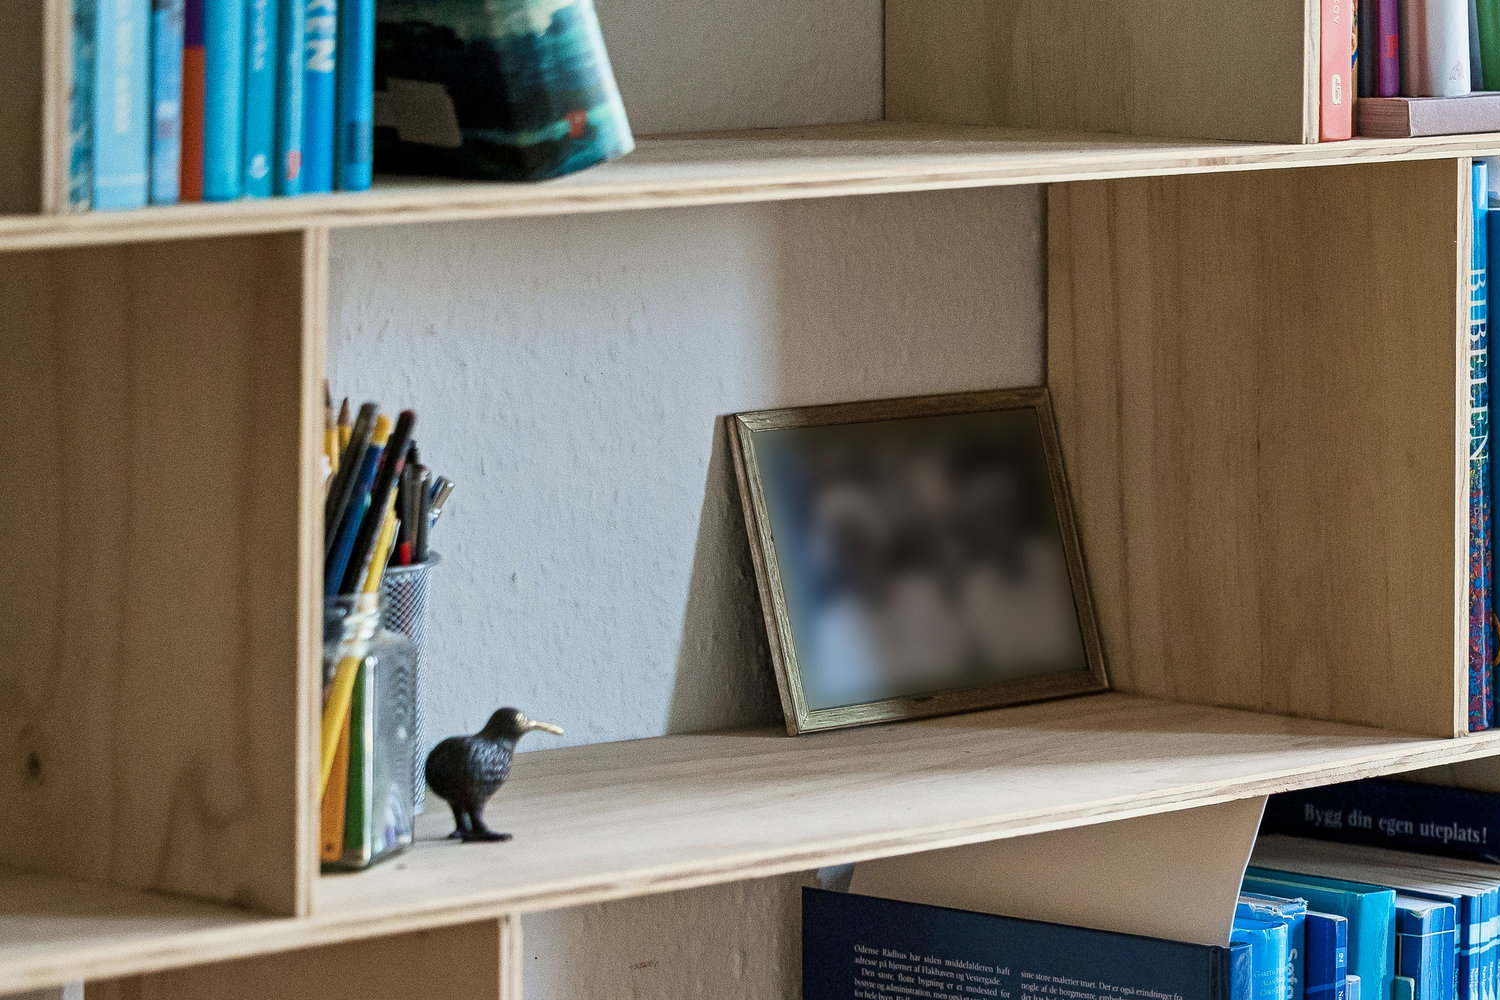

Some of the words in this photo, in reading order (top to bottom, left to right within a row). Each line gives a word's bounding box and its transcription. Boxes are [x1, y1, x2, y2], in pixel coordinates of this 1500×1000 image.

[1470, 268, 1489, 461] BIBELEN
[1305, 803, 1343, 829] Bygg
[1348, 810, 1371, 829] din
[1379, 817, 1413, 837] egen
[1420, 822, 1487, 844] uteplats!
